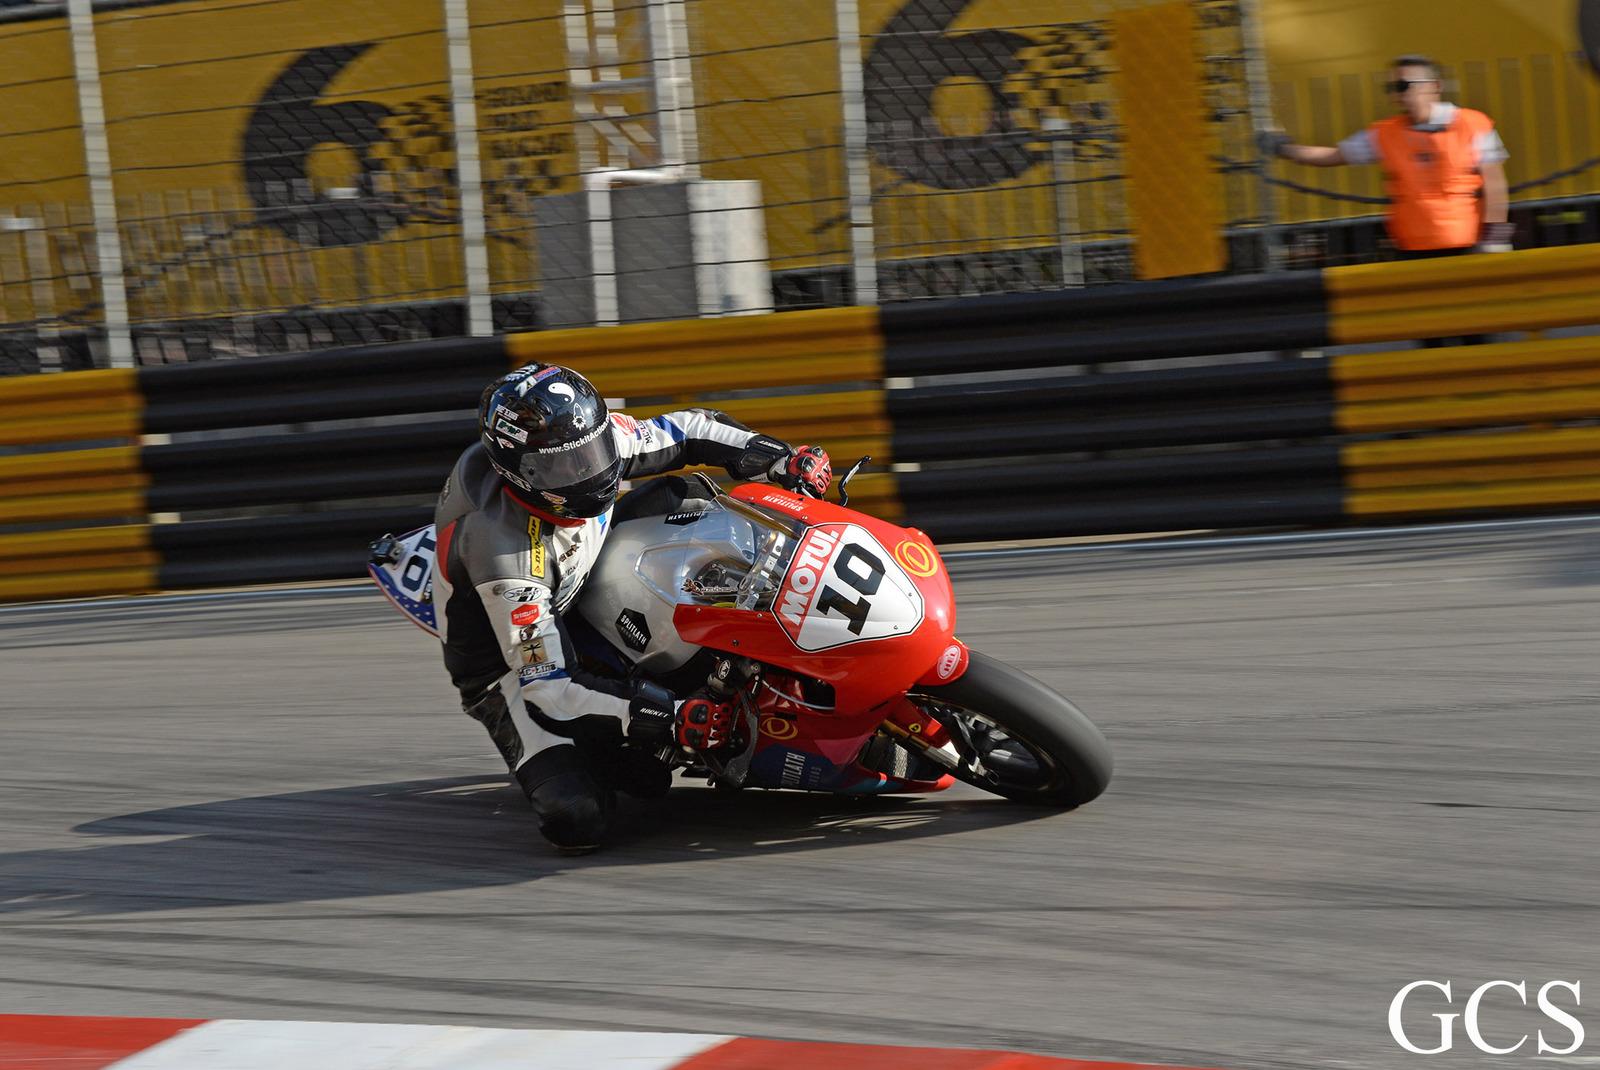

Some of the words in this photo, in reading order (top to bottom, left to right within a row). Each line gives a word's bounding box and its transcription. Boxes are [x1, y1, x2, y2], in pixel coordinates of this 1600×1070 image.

[763, 495, 804, 512] SPLITLATH
[780, 529, 840, 627] MOTUL
[816, 543, 886, 636] 10
[620, 614, 647, 646] SPLITLATH
[640, 707, 671, 719] ROCKET
